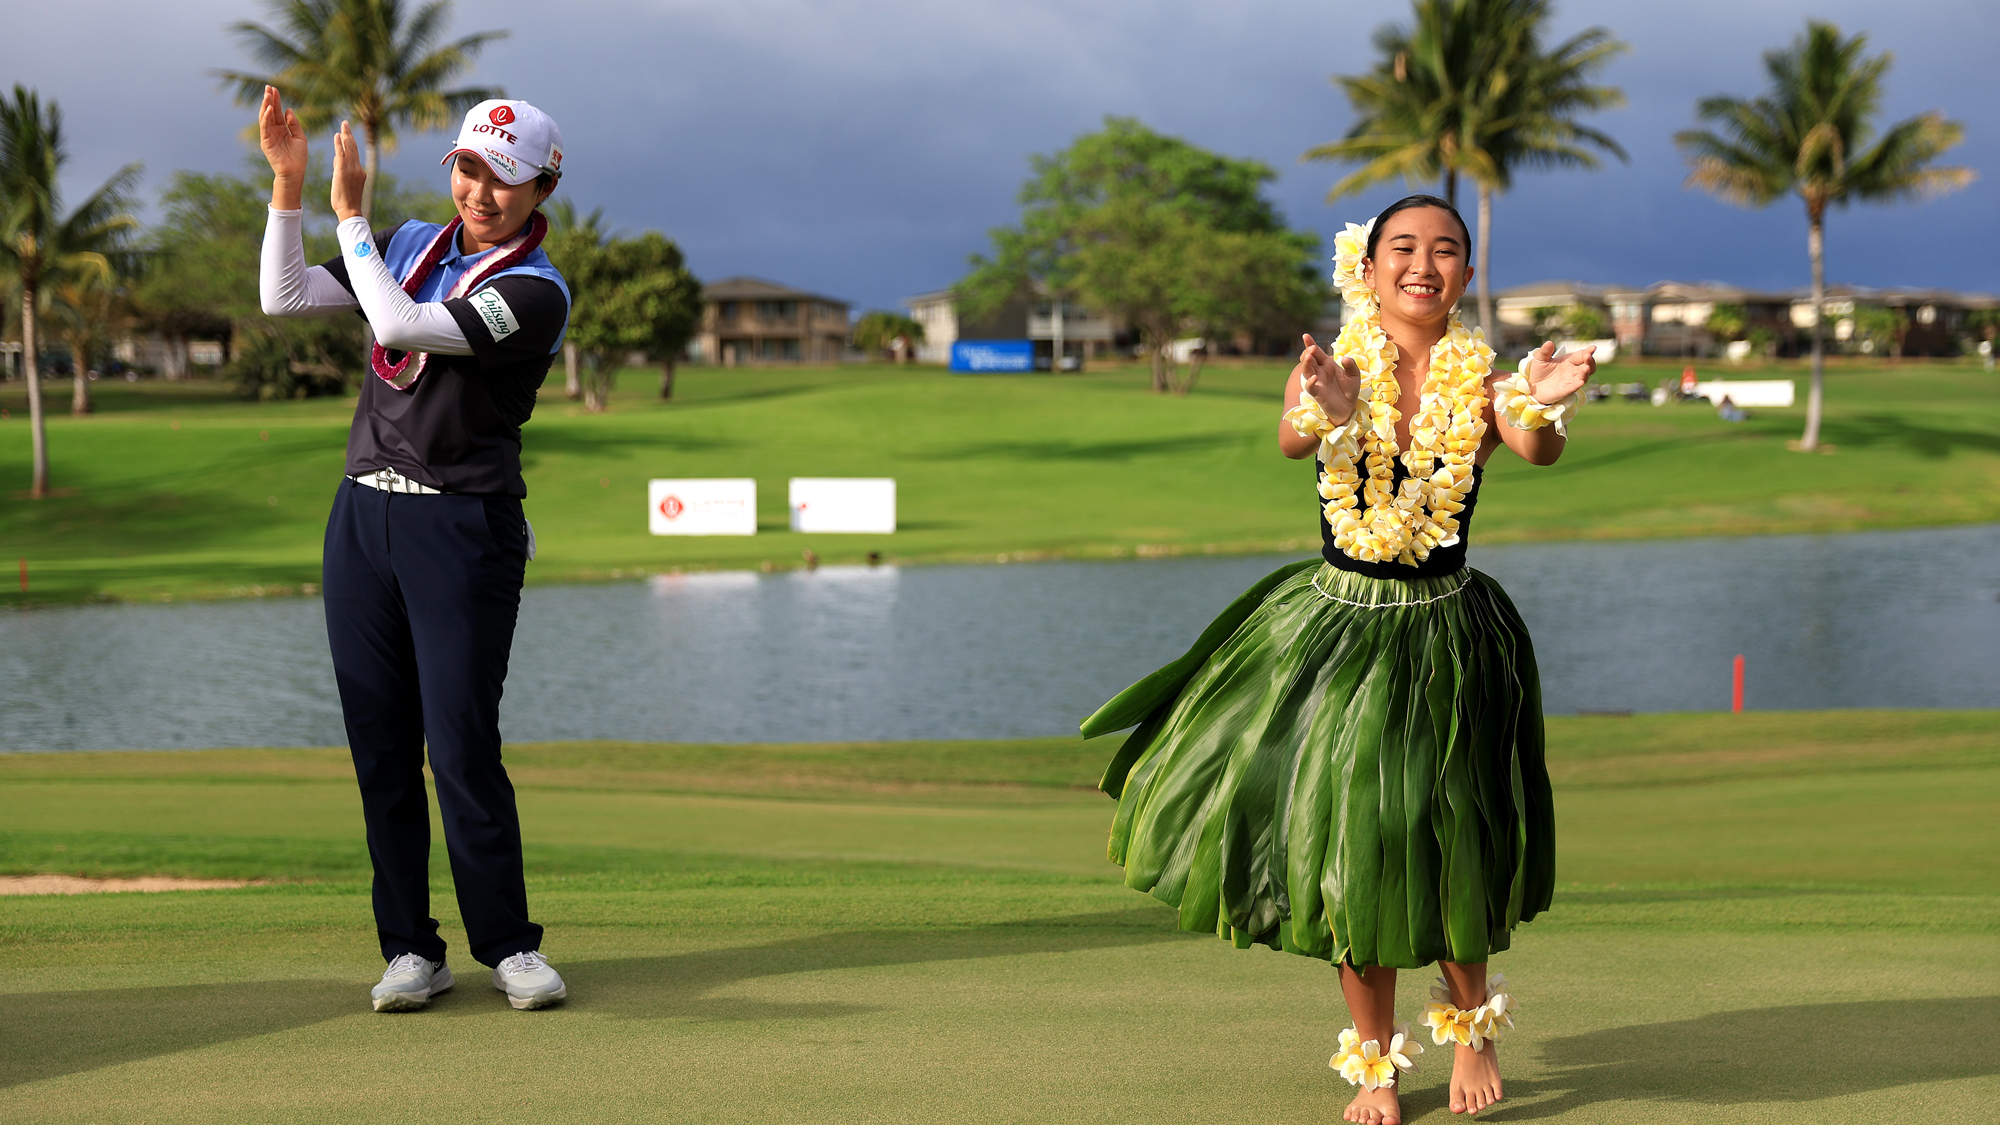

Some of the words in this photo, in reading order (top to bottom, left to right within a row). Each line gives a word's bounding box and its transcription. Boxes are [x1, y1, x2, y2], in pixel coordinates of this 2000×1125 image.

[473, 124, 518, 145] LOTTE
[485, 147, 517, 168] LOTTE
[487, 154, 514, 176] CHEMICAL
[479, 291, 510, 334] Chilsung
[480, 306, 497, 327] Cider
